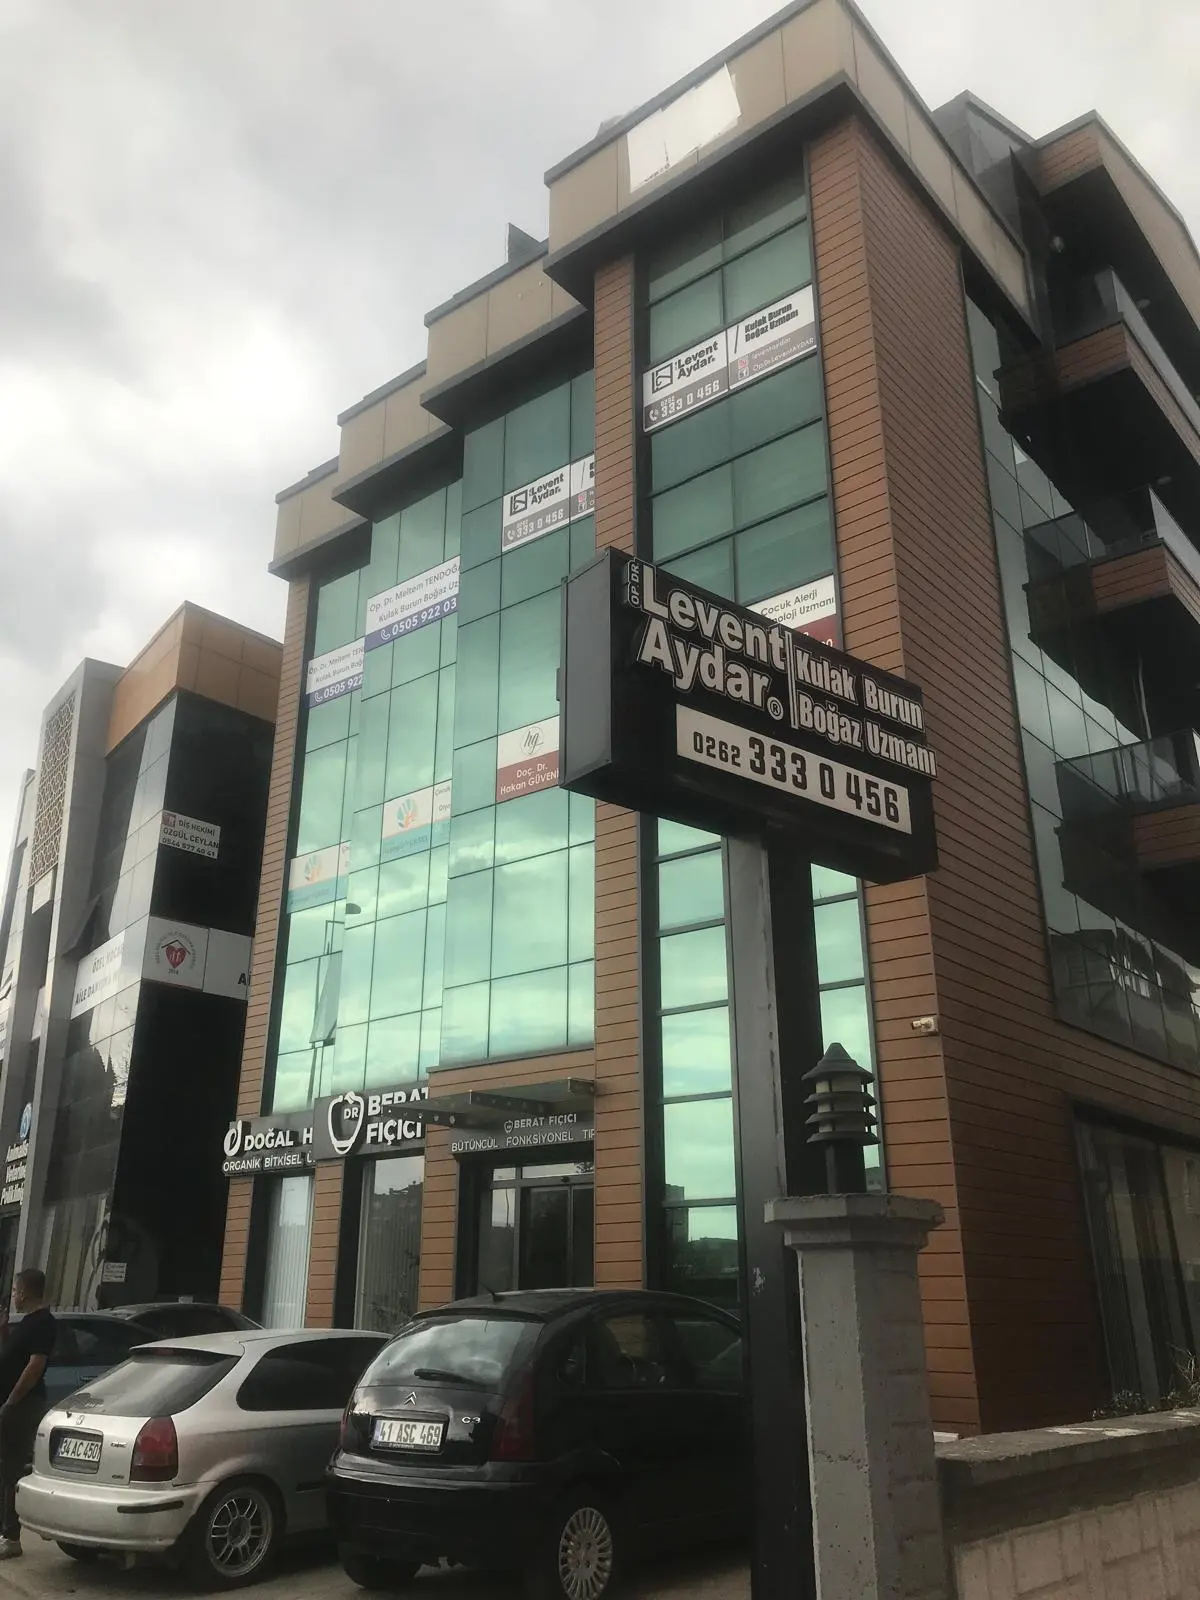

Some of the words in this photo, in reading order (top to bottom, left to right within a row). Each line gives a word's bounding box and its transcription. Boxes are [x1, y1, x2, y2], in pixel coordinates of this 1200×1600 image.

[745, 315, 768, 333] Kulak
[768, 303, 792, 323] Burun
[677, 340, 719, 368] Levent
[661, 398, 683, 418] 333
[697, 380, 720, 399] 456
[531, 473, 564, 495] Levent
[545, 509, 564, 524] 456
[395, 583, 424, 600] Meltem
[794, 589, 818, 605] Alerji
[378, 608, 399, 622] Kulak
[400, 598, 422, 613] Burun
[424, 586, 447, 602] Boğaz
[799, 597, 835, 615] Uzmanı
[392, 615, 418, 635] 0505
[421, 605, 441, 622] 922
[443, 597, 457, 613] 03
[641, 563, 787, 671] Levent
[323, 682, 346, 699] 0505
[794, 648, 858, 705] Kulak
[862, 674, 926, 733] Burun
[797, 693, 865, 751] Boğaz
[865, 720, 937, 778] Uzmanı
[537, 763, 548, 772] Dr.
[693, 731, 741, 768] 0262
[749, 737, 808, 791] 333
[819, 763, 835, 800] 0
[846, 772, 900, 824] 456
[500, 781, 526, 795] Hakan
[190, 835, 219, 849] CEYLAN
[343, 1107, 359, 1120] DR
[513, 1117, 545, 1129] BERAT
[548, 1113, 577, 1126] FIÇICI
[244, 1128, 294, 1151] DOĞAL
[366, 1119, 422, 1146] FIÇICI
[451, 1138, 499, 1151] BÜTÜNCÜL
[506, 1132, 574, 1147] FONKSİYONEL
[223, 1157, 261, 1171] ORGANİK
[264, 1153, 302, 1168] BİTKİSEL
[379, 1422, 393, 1441] 41
[396, 1423, 417, 1443] ASC
[420, 1425, 441, 1445] 469
[61, 1438, 71, 1455] 34
[71, 1440, 84, 1457] AC
